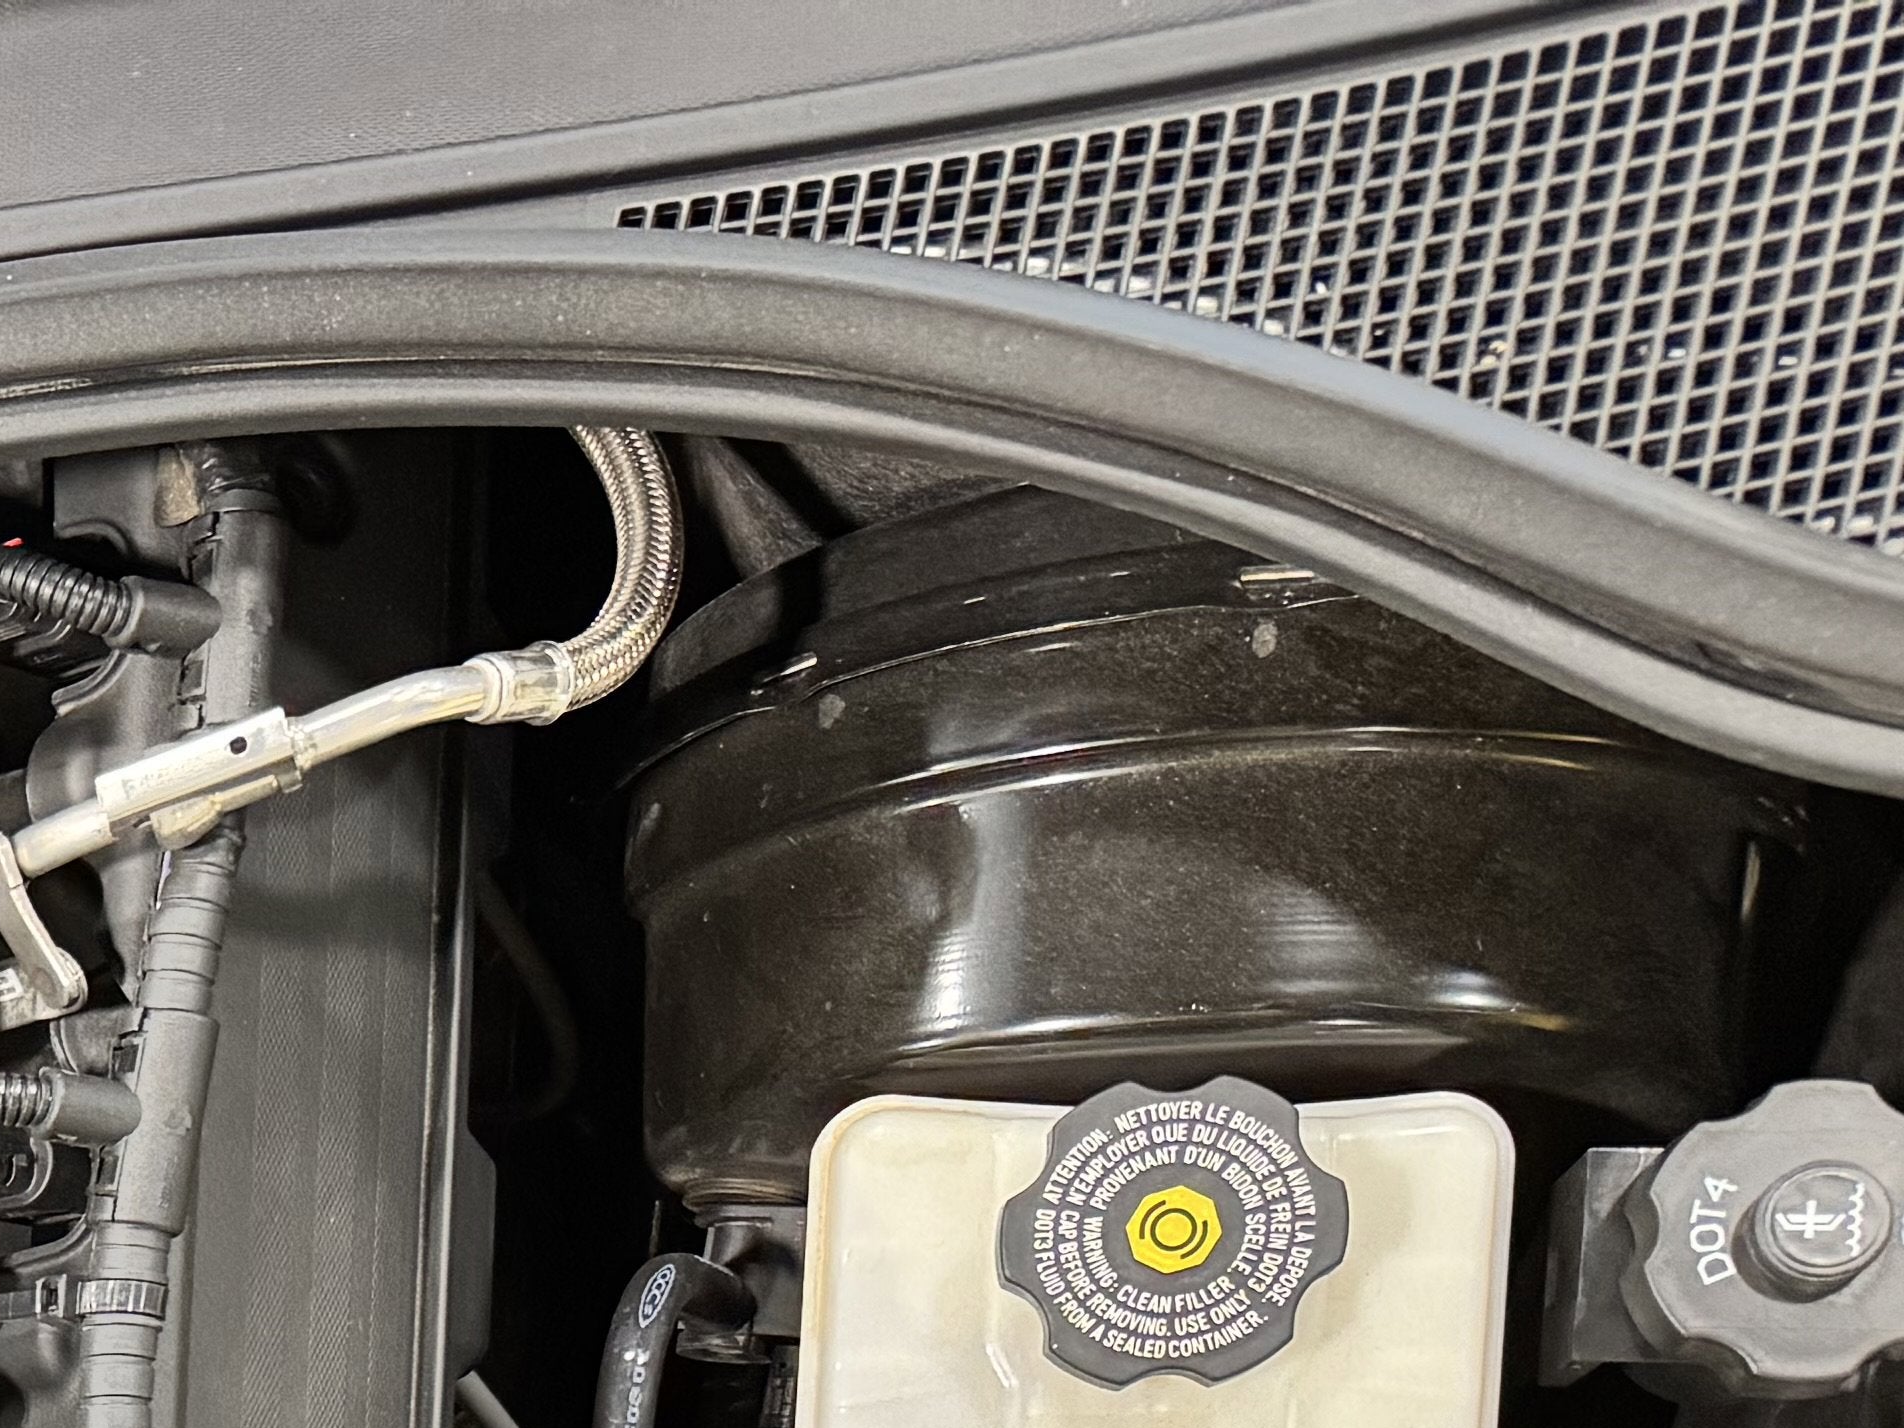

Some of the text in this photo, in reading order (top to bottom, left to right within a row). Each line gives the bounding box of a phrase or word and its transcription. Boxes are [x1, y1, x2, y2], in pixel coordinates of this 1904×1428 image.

[1114, 1100, 1202, 1133] NETTOYER
[1209, 1103, 1230, 1124] LE
[1228, 1110, 1298, 1167] BOUCHON
[1042, 1129, 1113, 1205] ATTENTION:
[1090, 1146, 1177, 1211] PROVENANT
[1183, 1146, 1226, 1172] D'UN
[1223, 1163, 1264, 1210] BIDON
[1284, 1165, 1316, 1218] AVANT
[1066, 1123, 1291, 1293] N'EMPLOYER QUE DU LIQUIDE DE FREIN DOT3
[1295, 1220, 1315, 1243] LA
[1034, 1209, 1270, 1359] DOT3 FLUID FROM A SEALED CONTAINER.
[1058, 1211, 1252, 1337] CAP BEFORE REMOVING. USE ONLY
[1083, 1216, 1235, 1313] WARNING: CLEAN FILLER
